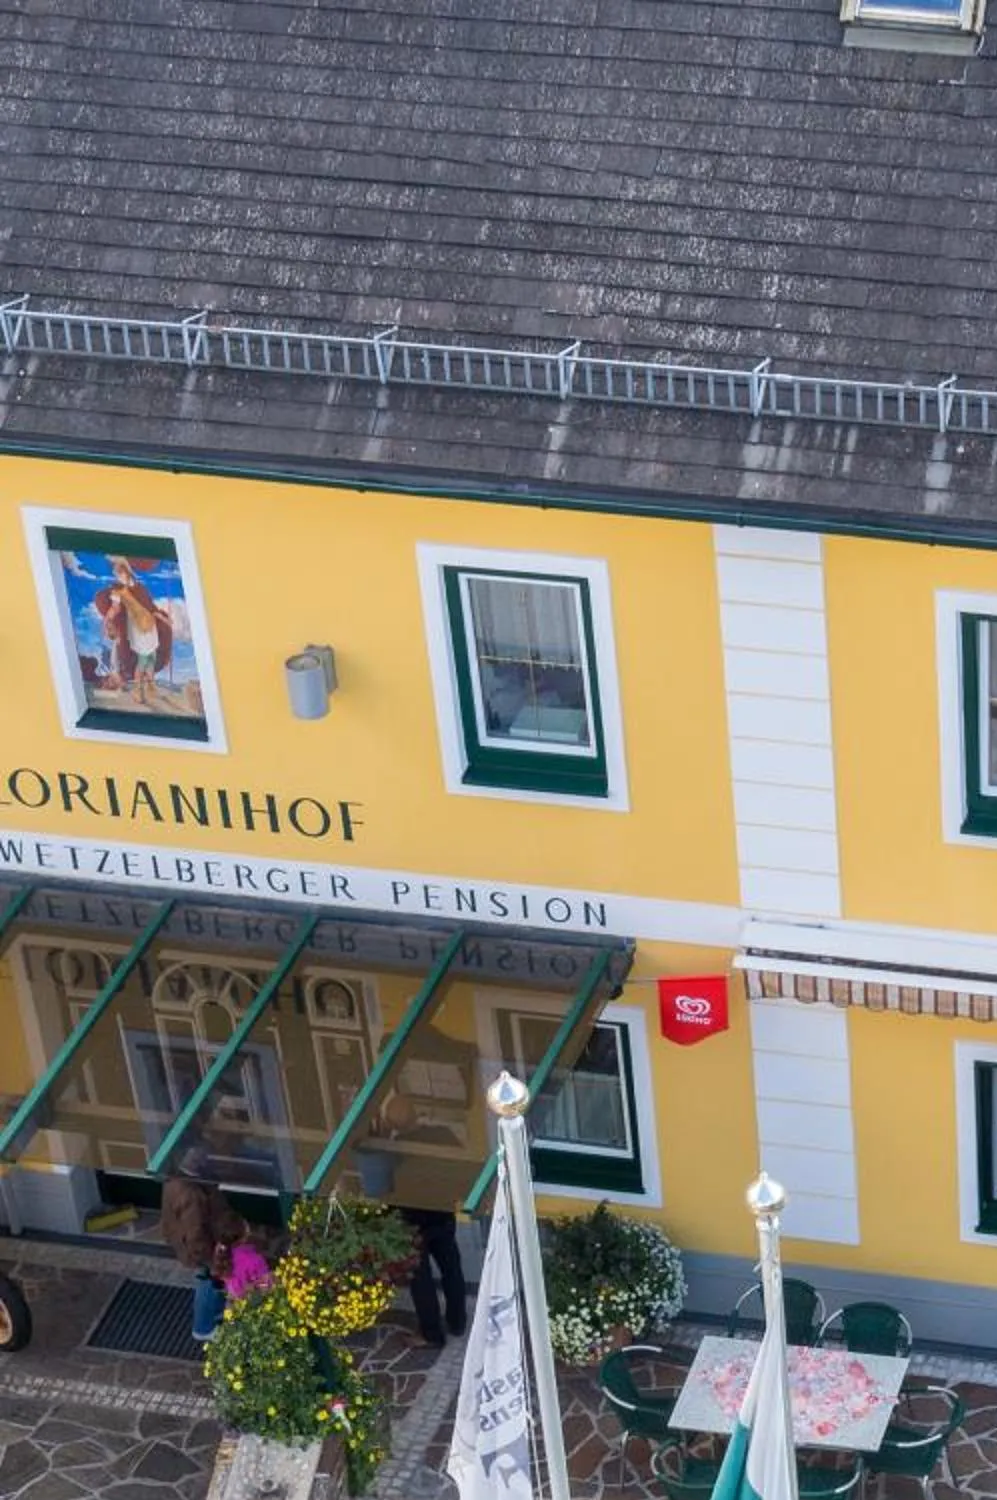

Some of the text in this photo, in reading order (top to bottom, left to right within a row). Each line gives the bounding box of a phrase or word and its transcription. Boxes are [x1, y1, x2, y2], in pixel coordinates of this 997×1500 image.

[0, 767, 364, 842] ORIANIHOF
[0, 837, 607, 927] WETZELBERGER PENSION
